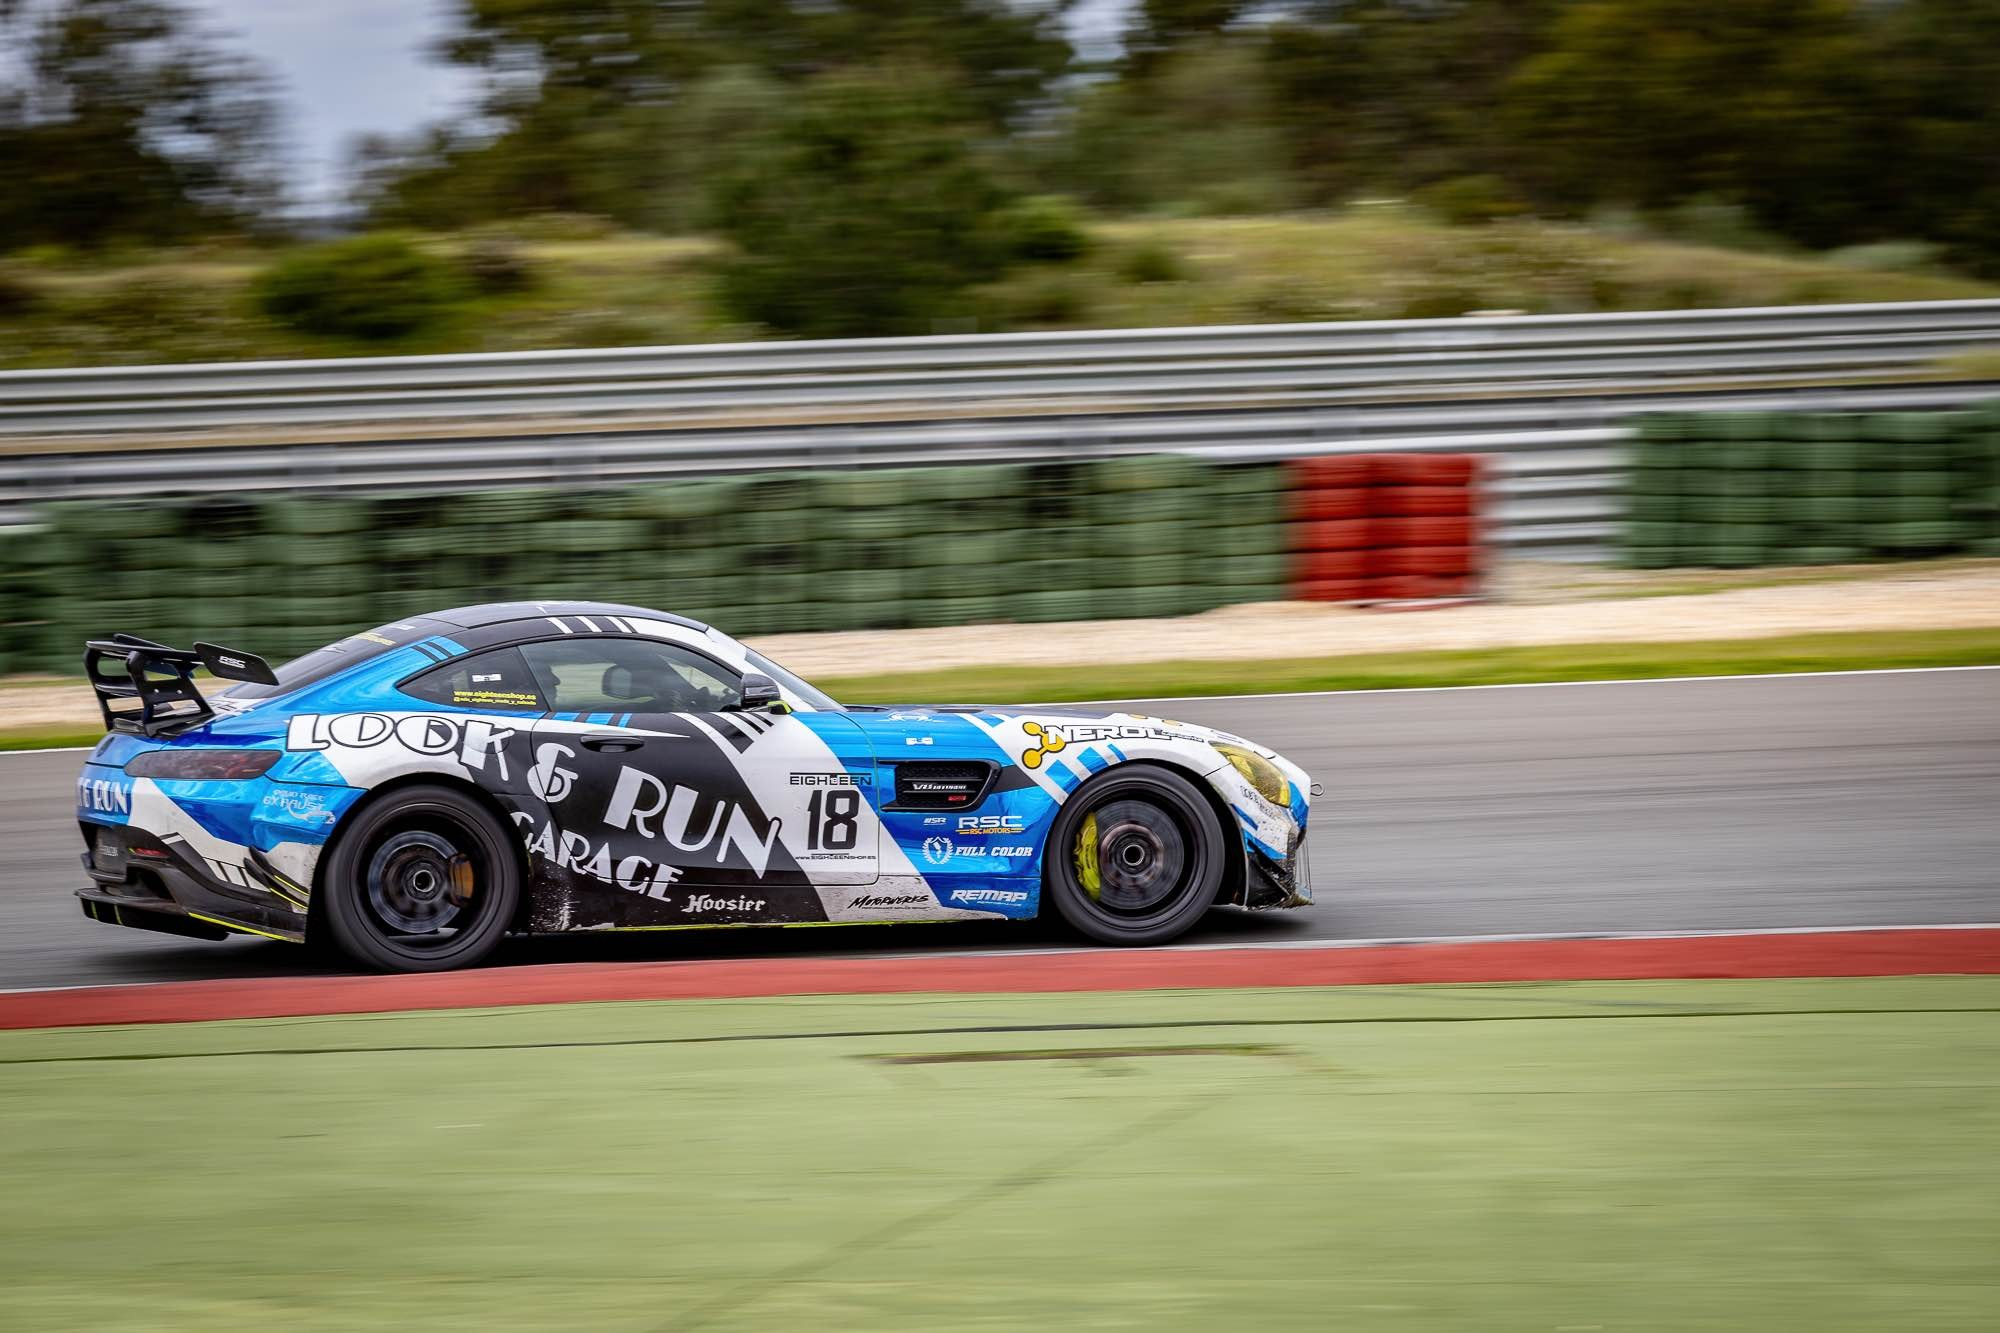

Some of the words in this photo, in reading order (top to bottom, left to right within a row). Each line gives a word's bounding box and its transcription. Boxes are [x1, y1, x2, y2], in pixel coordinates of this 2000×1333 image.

[1044, 725, 1172, 744] NEROL
[93, 779, 130, 815] RUN
[286, 712, 515, 782] LOOK
[527, 742, 579, 803] &
[603, 765, 782, 880] RUN
[806, 789, 860, 850] 18
[958, 815, 1023, 829] RSC
[955, 846, 987, 857] FULL
[991, 846, 1034, 857] COLOR
[681, 894, 767, 913] Hoosier
[950, 889, 1029, 905] REMAP
